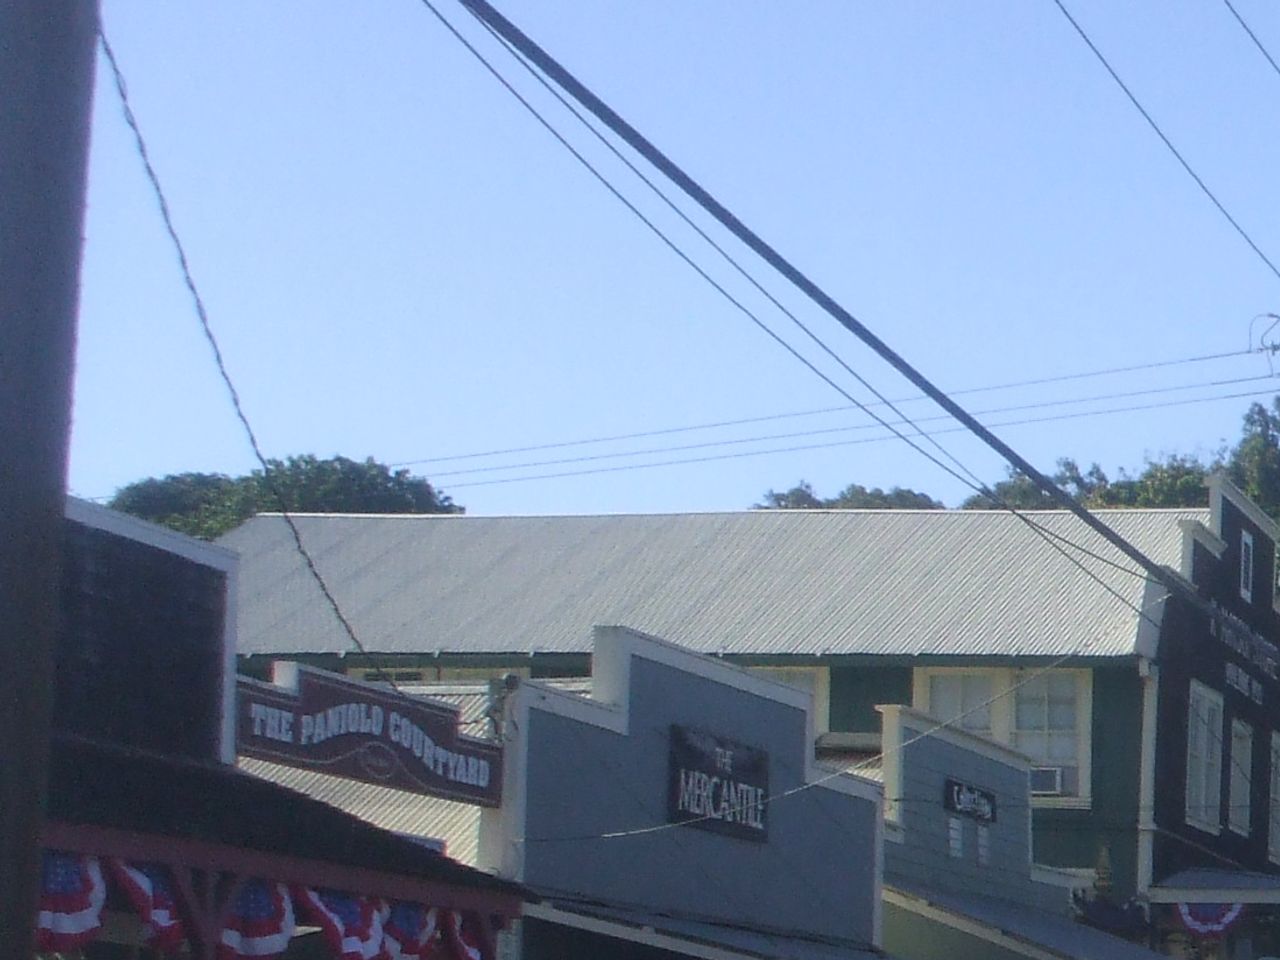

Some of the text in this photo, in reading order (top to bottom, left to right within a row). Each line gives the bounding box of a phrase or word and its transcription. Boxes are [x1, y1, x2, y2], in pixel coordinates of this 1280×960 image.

[251, 703, 491, 788] THE PANIOLO COURTYARD
[714, 747, 733, 774] THE
[678, 768, 764, 830] MERCANTILE
